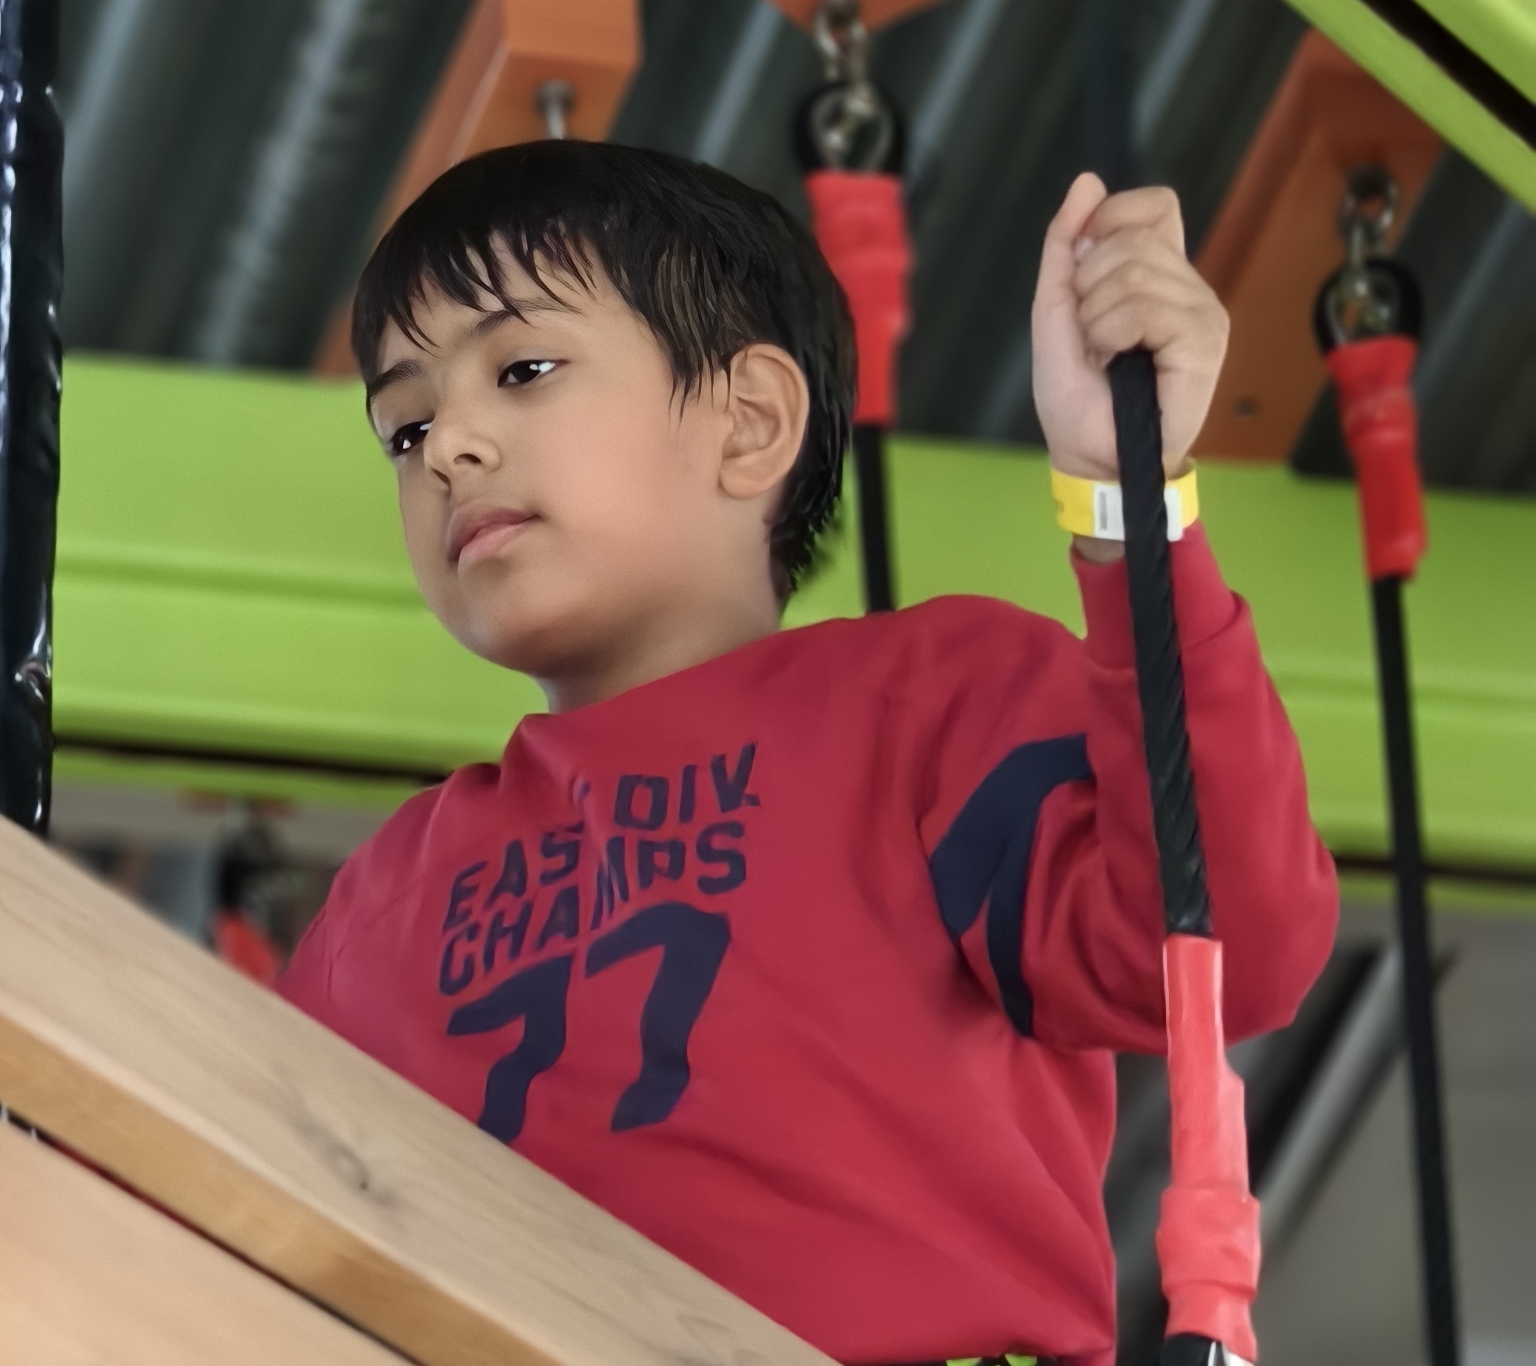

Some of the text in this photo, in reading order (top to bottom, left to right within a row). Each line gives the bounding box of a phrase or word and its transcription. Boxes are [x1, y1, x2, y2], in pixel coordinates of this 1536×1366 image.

[438, 821, 747, 996] CHAMPS
[441, 785, 588, 931] EAS
[446, 901, 732, 1146] 77
